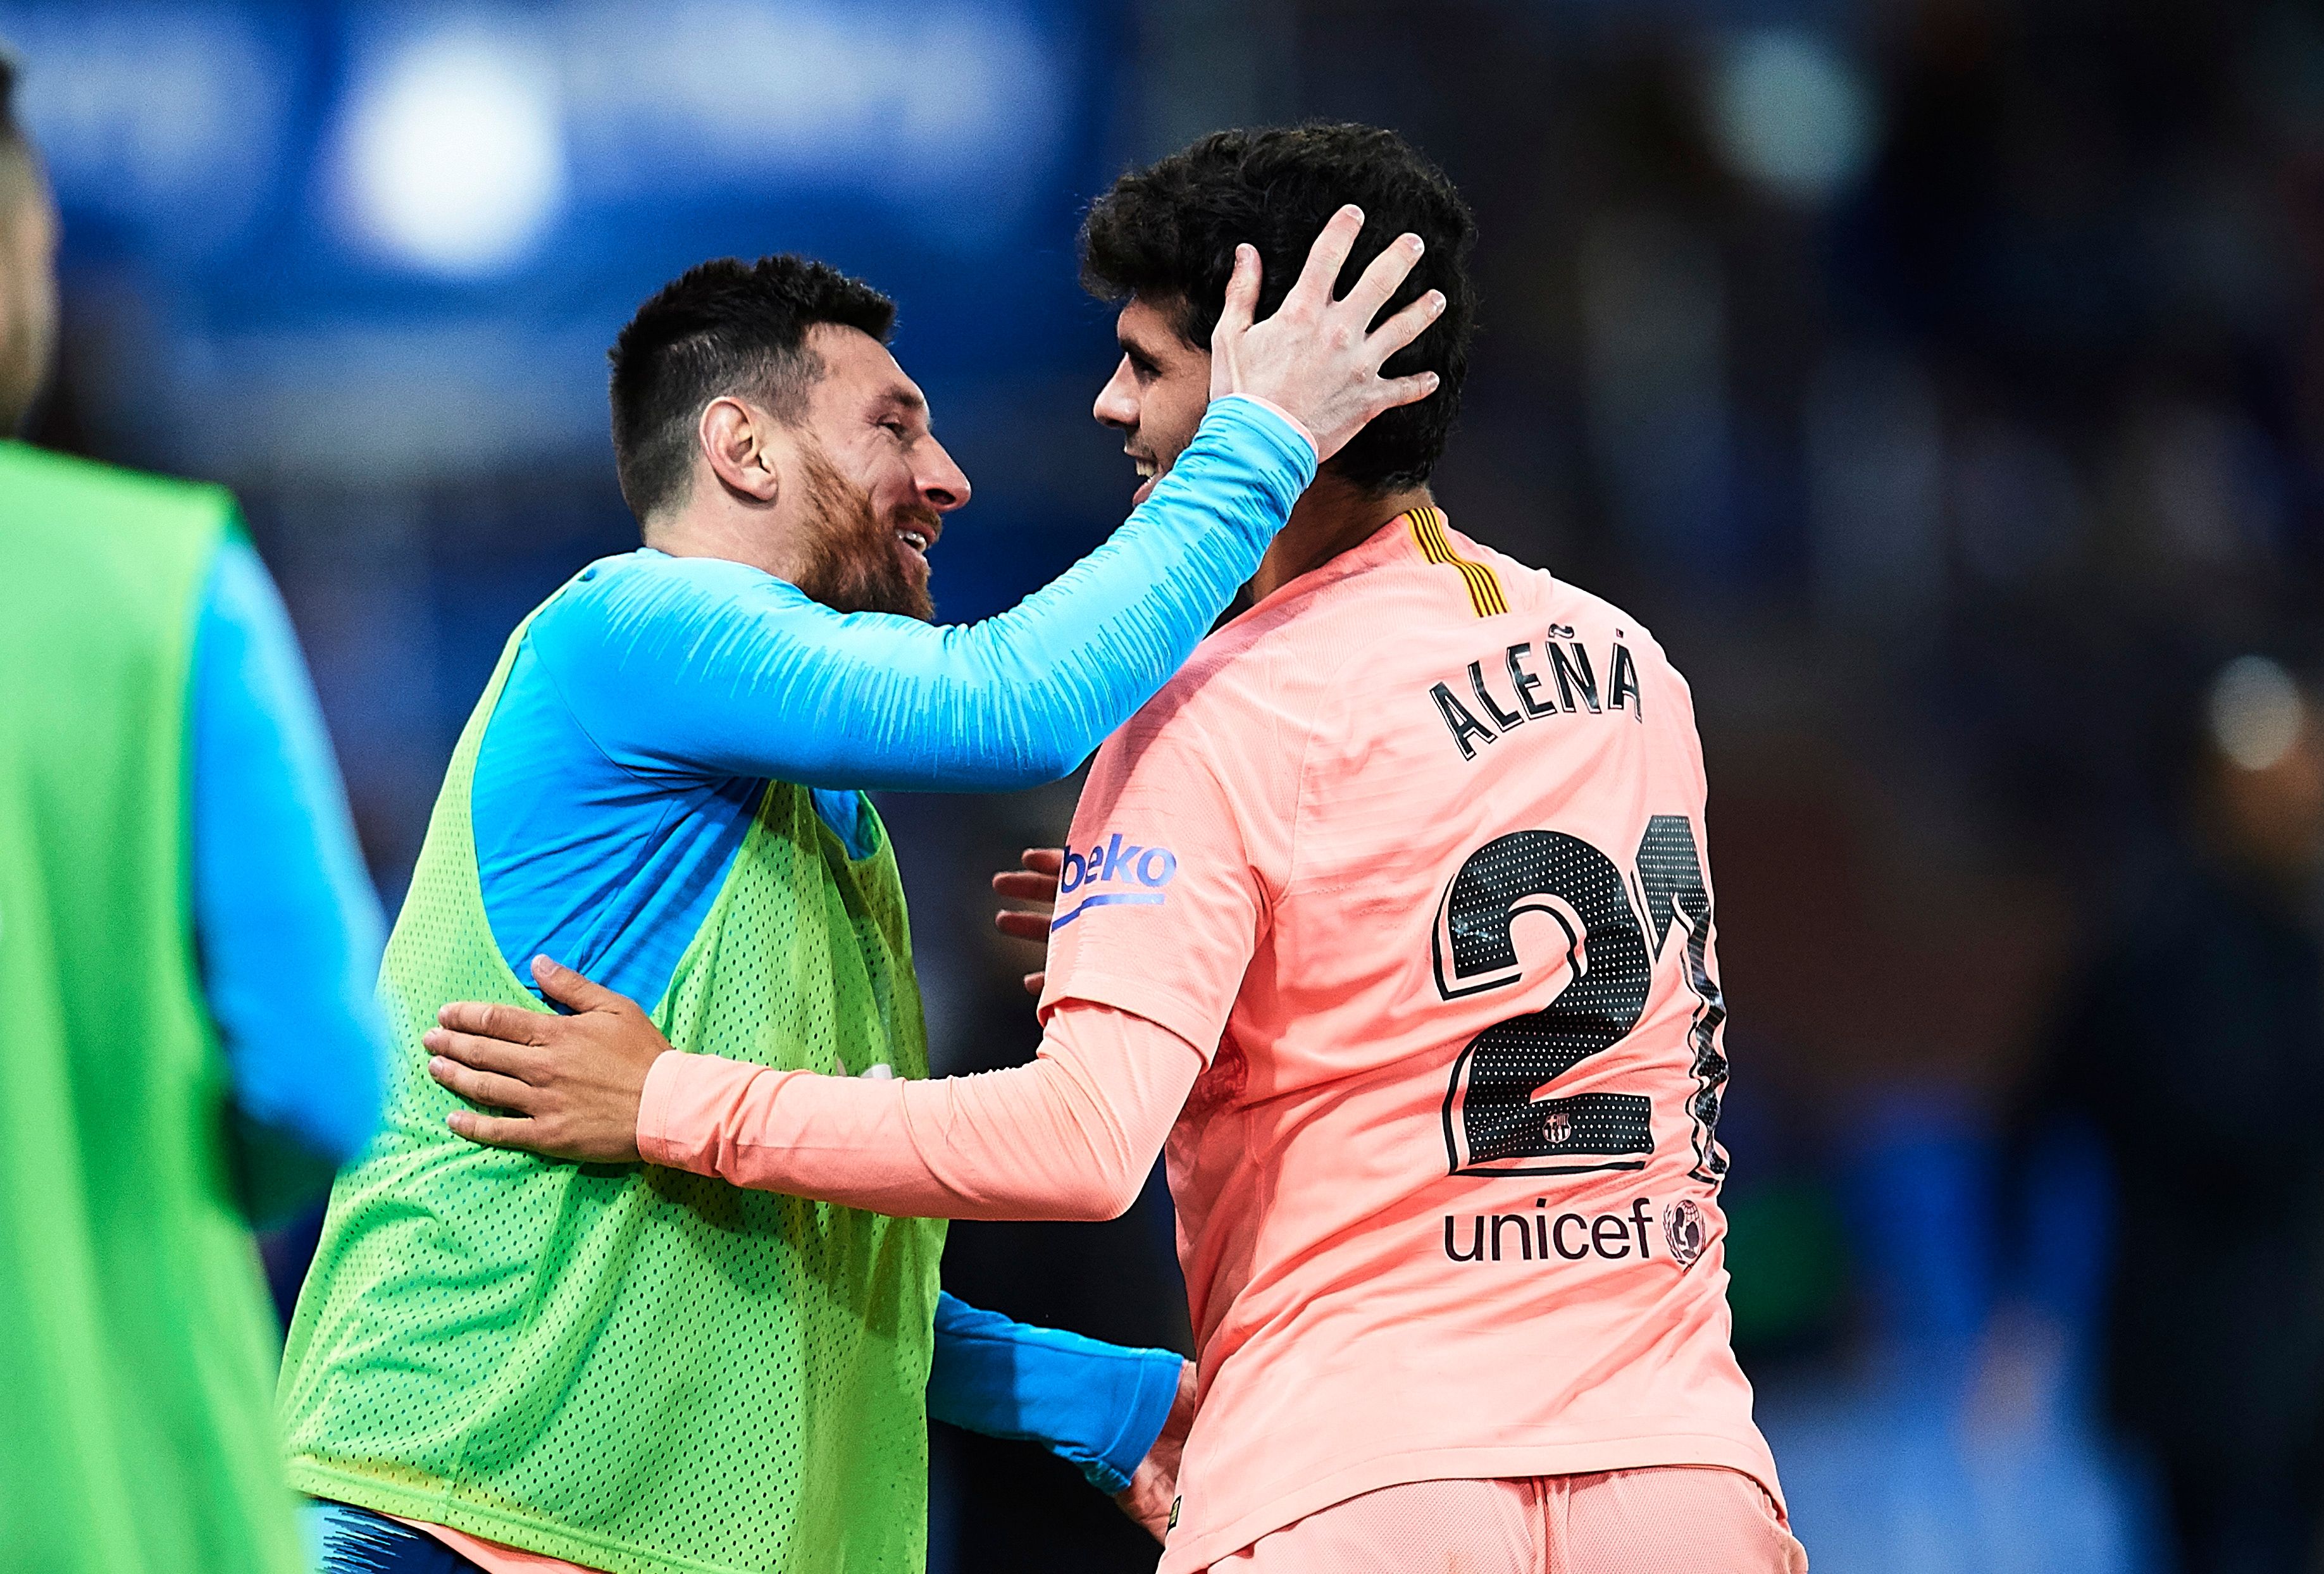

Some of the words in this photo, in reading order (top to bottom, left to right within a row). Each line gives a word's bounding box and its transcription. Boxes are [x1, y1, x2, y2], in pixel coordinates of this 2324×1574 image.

[1061, 833, 1177, 893] beko
[1432, 815, 1728, 1184] 21
[1445, 1198, 1653, 1262] unicef
